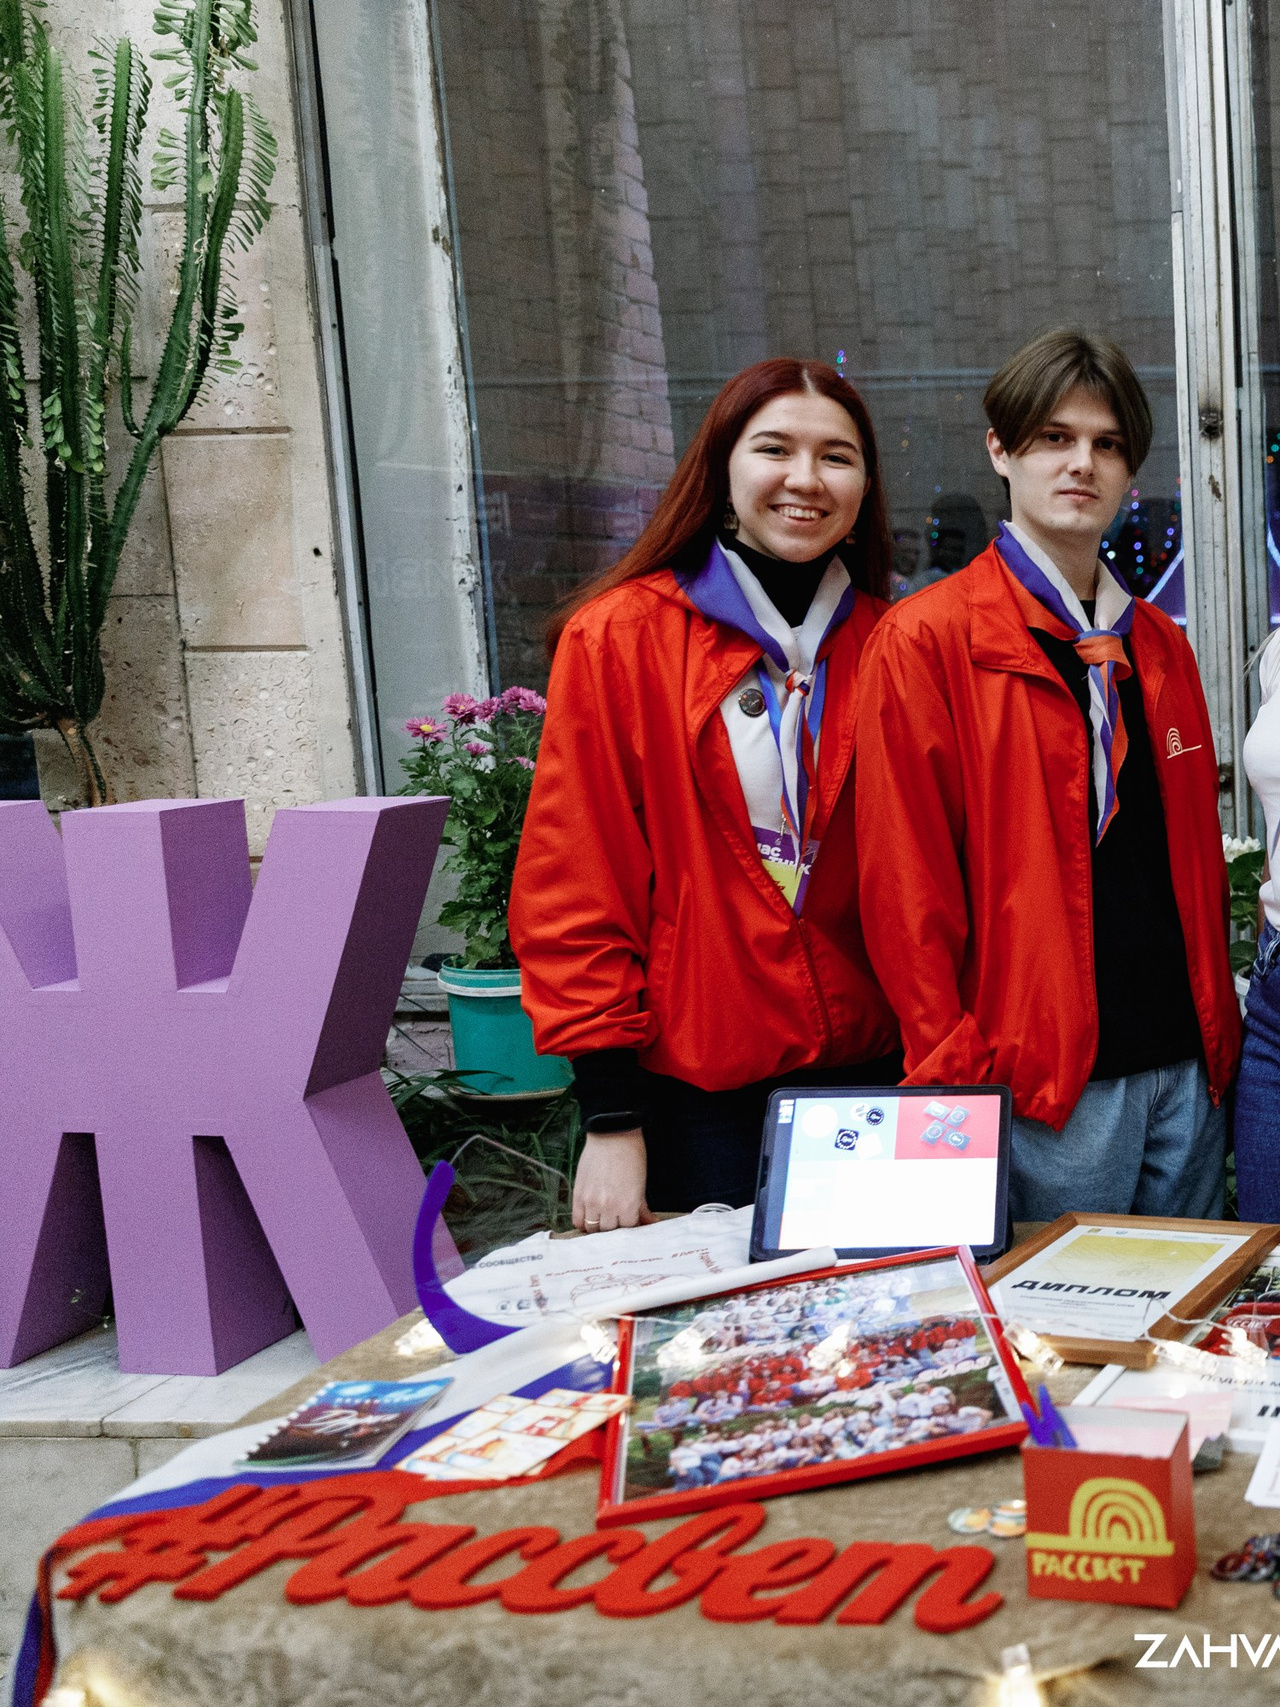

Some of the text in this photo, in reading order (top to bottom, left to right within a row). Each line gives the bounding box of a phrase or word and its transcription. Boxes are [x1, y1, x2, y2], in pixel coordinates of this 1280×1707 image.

[479, 1254, 543, 1268] СООБЩЕСТВО
[1011, 1280, 1172, 1300] ДИПЛОМ
[56, 1483, 1004, 1634] #Рассвет
[1032, 1551, 1146, 1584] РАССВЕТ
